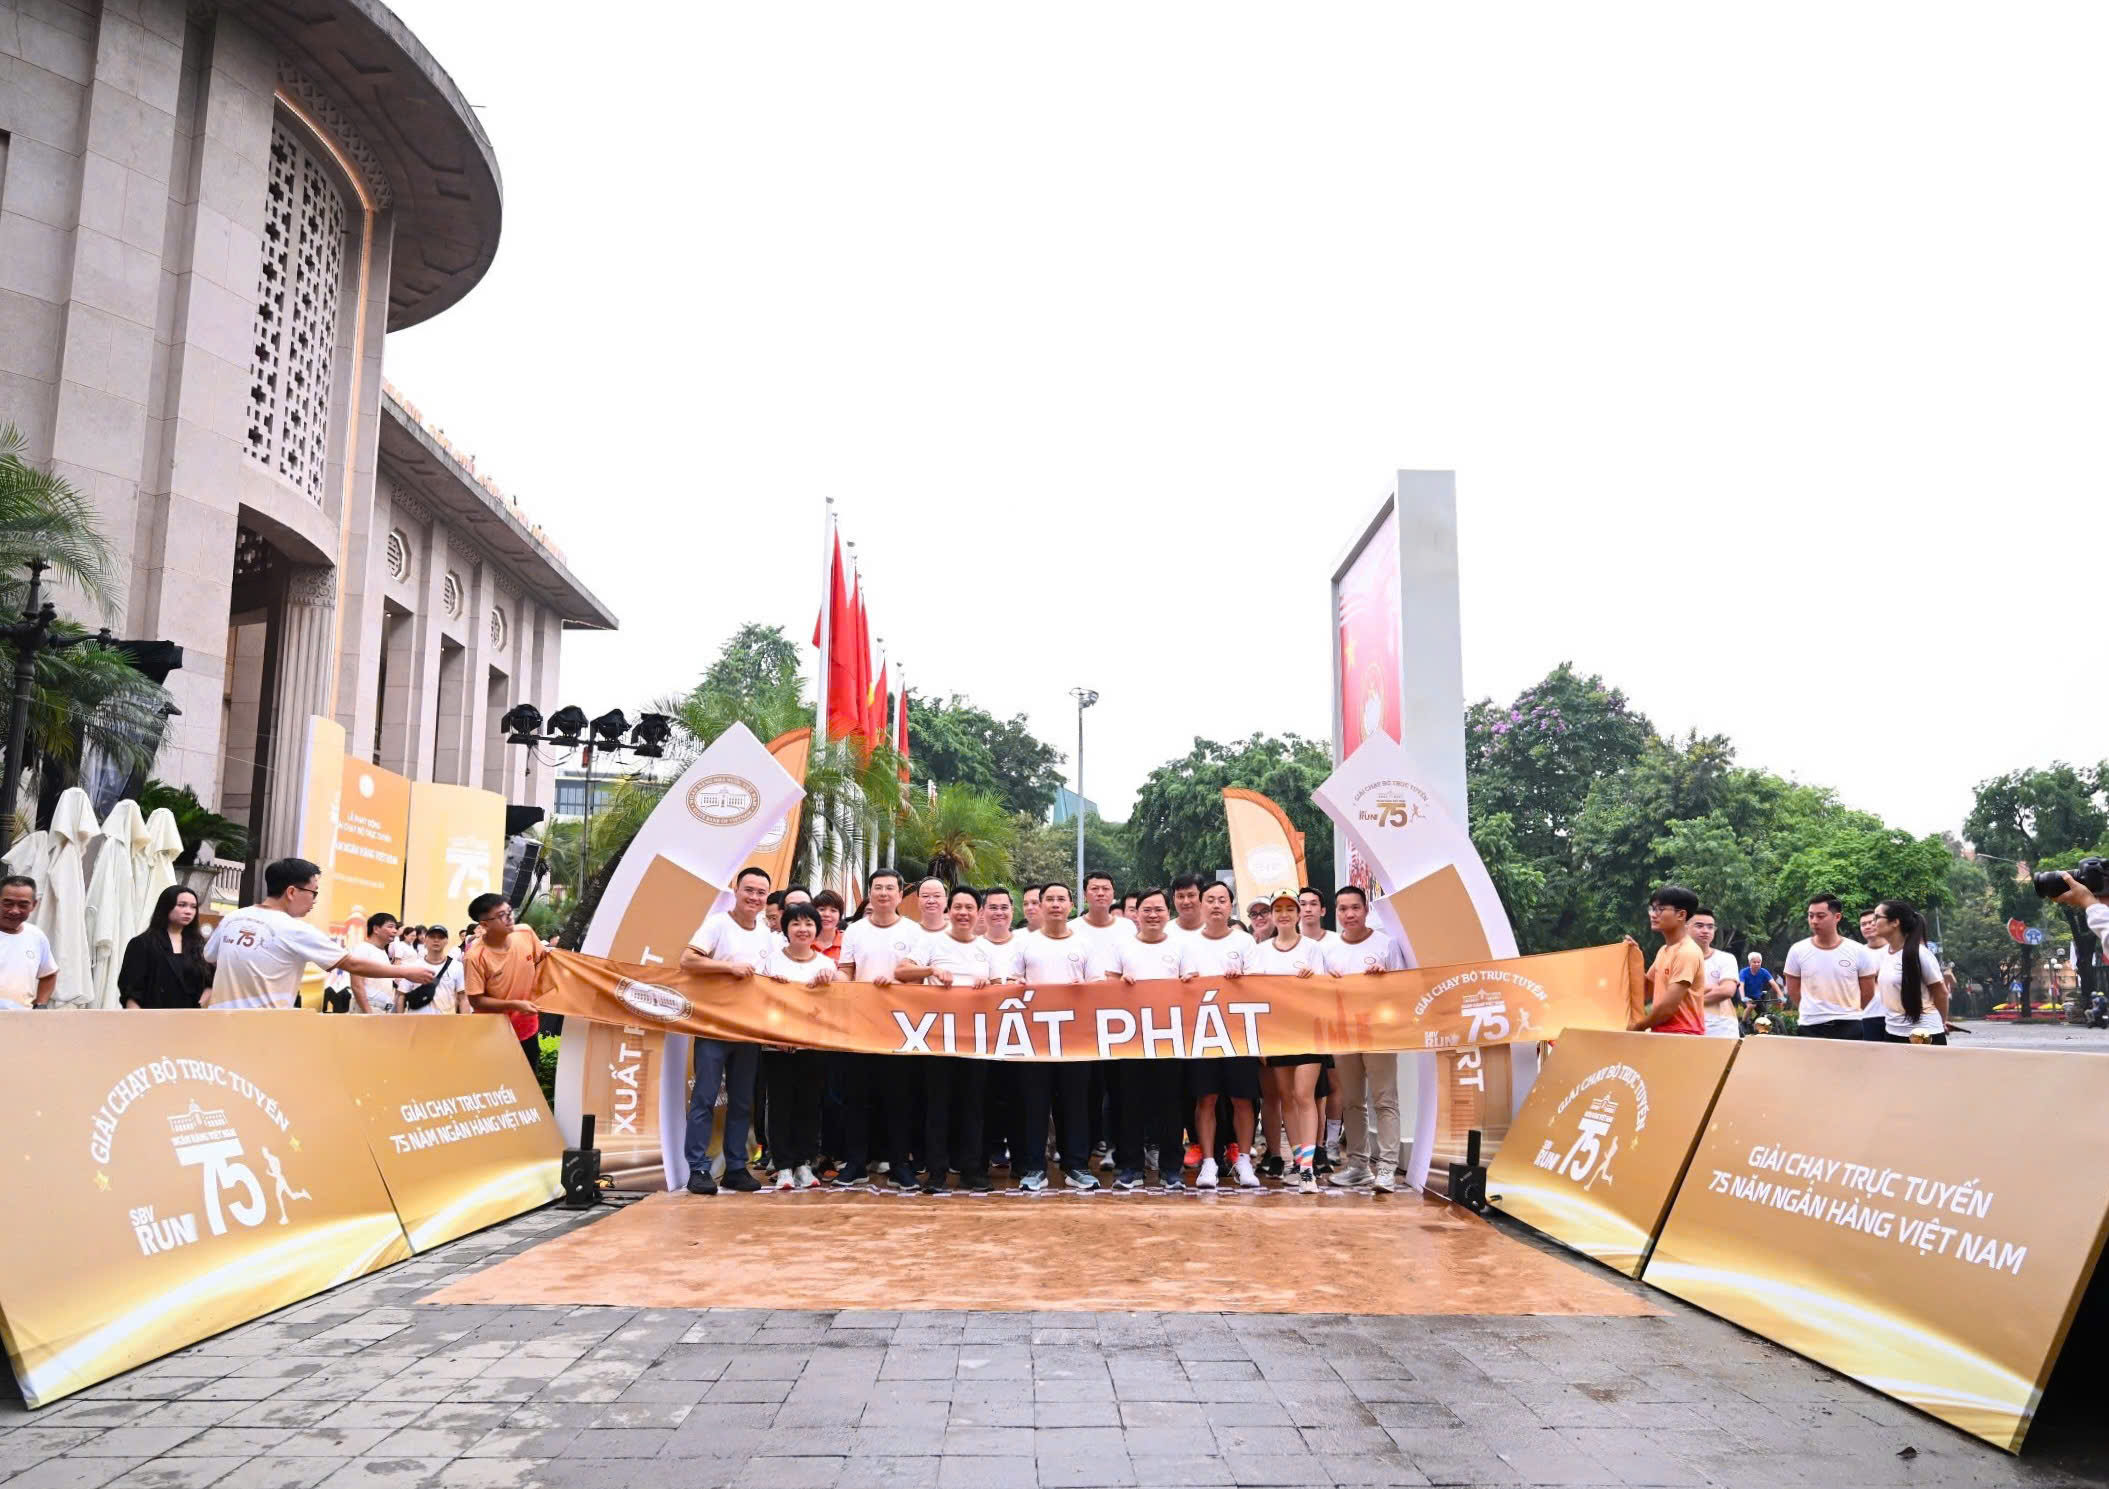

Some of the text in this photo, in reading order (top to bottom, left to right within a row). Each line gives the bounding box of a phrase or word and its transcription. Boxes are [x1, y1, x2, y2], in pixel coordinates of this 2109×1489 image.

[1376, 802, 1408, 828] 75
[236, 930, 257, 947] 75
[892, 989, 1271, 1058] XUẤT PHÁT
[1425, 1036, 1460, 1048] RUN
[1461, 1004, 1510, 1043] 75
[90, 1106, 119, 1164] GIẢI
[107, 1067, 152, 1114] CHẠY
[149, 1056, 177, 1084] BỘ
[175, 1058, 227, 1086] TRỰC
[400, 1098, 427, 1123] GIẢI
[425, 1098, 459, 1120] CHẠY
[608, 1042, 643, 1136] XUẤT
[389, 1135, 411, 1154] 75
[497, 1110, 521, 1132] VIỆT
[517, 1108, 541, 1126] NAM
[1558, 1117, 1611, 1182] 75
[1534, 1149, 1561, 1171] RUN
[1747, 1142, 1994, 1219] GIẢI CHẠY TRỰC TUYẾN
[174, 1137, 267, 1236] 75
[129, 1205, 155, 1227] SBV
[134, 1213, 199, 1256] RUN
[1708, 1169, 2028, 1276] 75 NĂM NGÂN HÀNG VIỆT NAM
